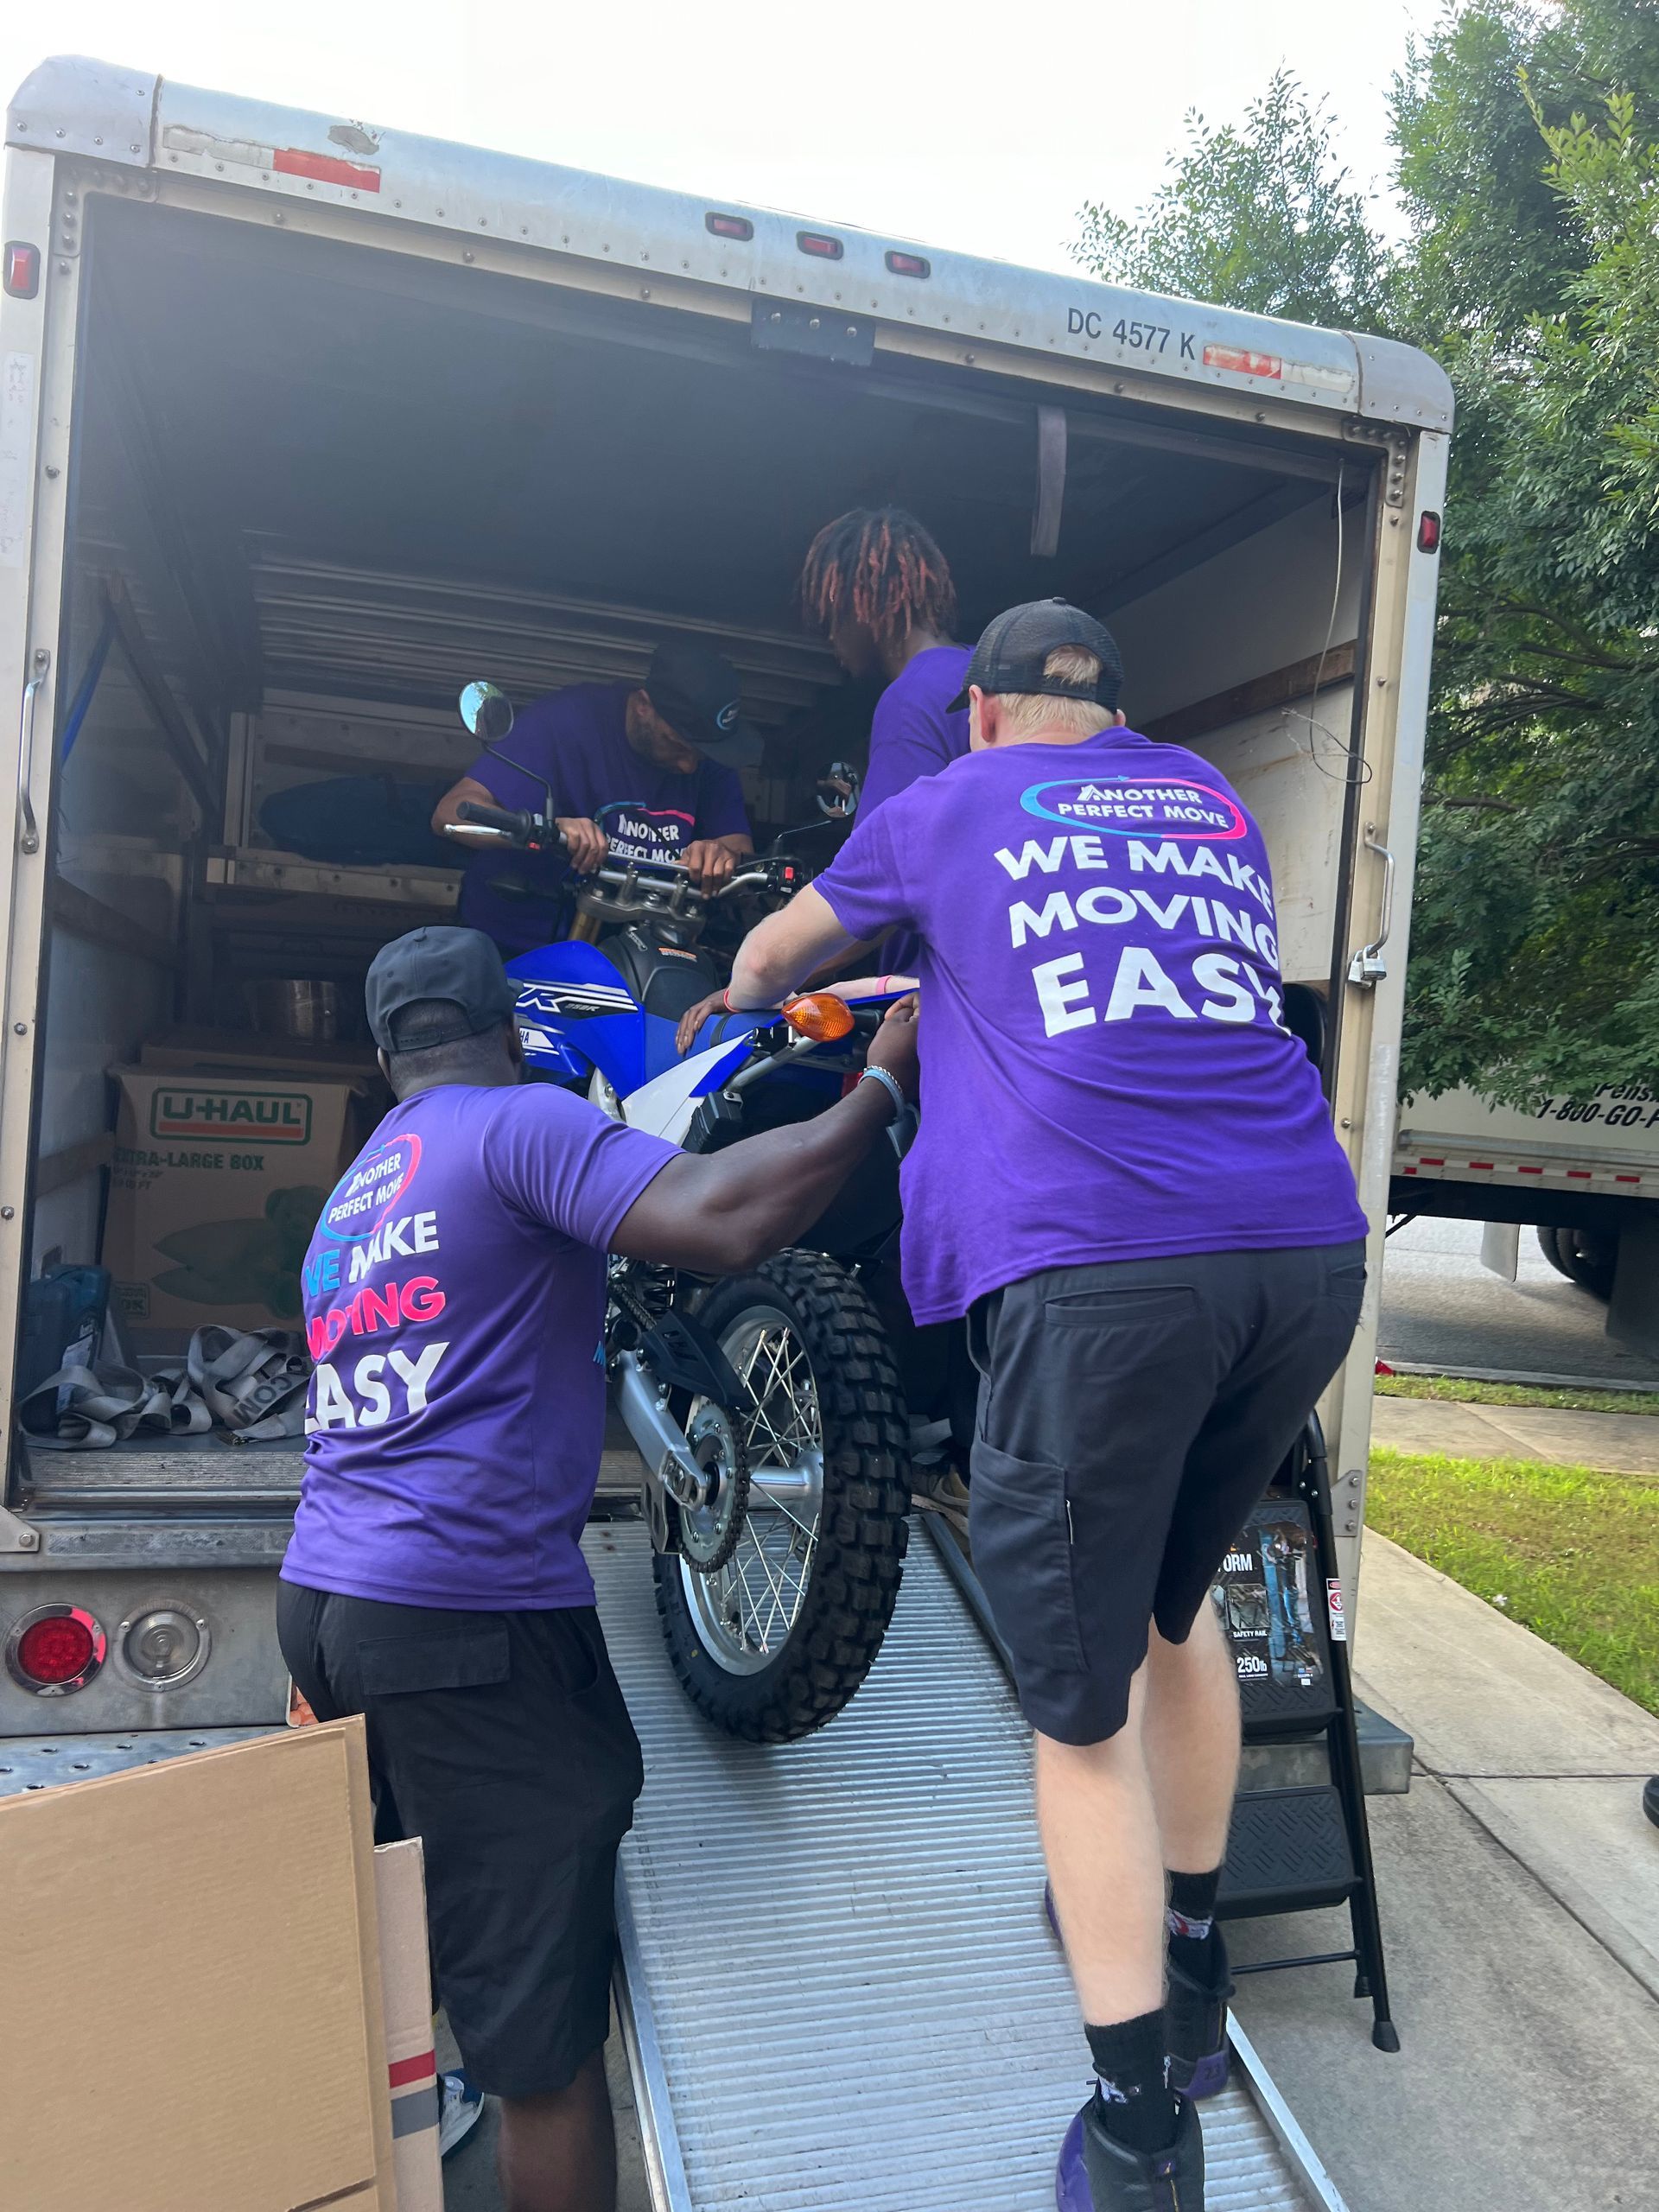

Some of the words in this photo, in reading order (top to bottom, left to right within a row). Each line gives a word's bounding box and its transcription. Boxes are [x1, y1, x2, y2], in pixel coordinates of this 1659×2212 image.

[1067, 308, 1102, 339] DC
[1112, 319, 1171, 353] 4577
[1180, 332, 1196, 359] K
[1077, 784, 1203, 804] ANOTHER
[1057, 803, 1154, 818] PERFECT
[1163, 805, 1229, 829] MOVE
[651, 846, 685, 864] MO
[994, 836, 1109, 880] WE
[1127, 840, 1274, 921] MAKE
[1008, 887, 1279, 971] MOVING
[1594, 1081, 1659, 1103] Pens
[162, 1096, 301, 1125] U-HAUL
[230, 1154, 264, 1171] BOX
[327, 1191, 374, 1224] PERFECT
[375, 1172, 404, 1205] MOVE
[304, 1342, 450, 1435] ASY
[1217, 1553, 1253, 1573] ORM
[1236, 1656, 1268, 1674] 250lb
